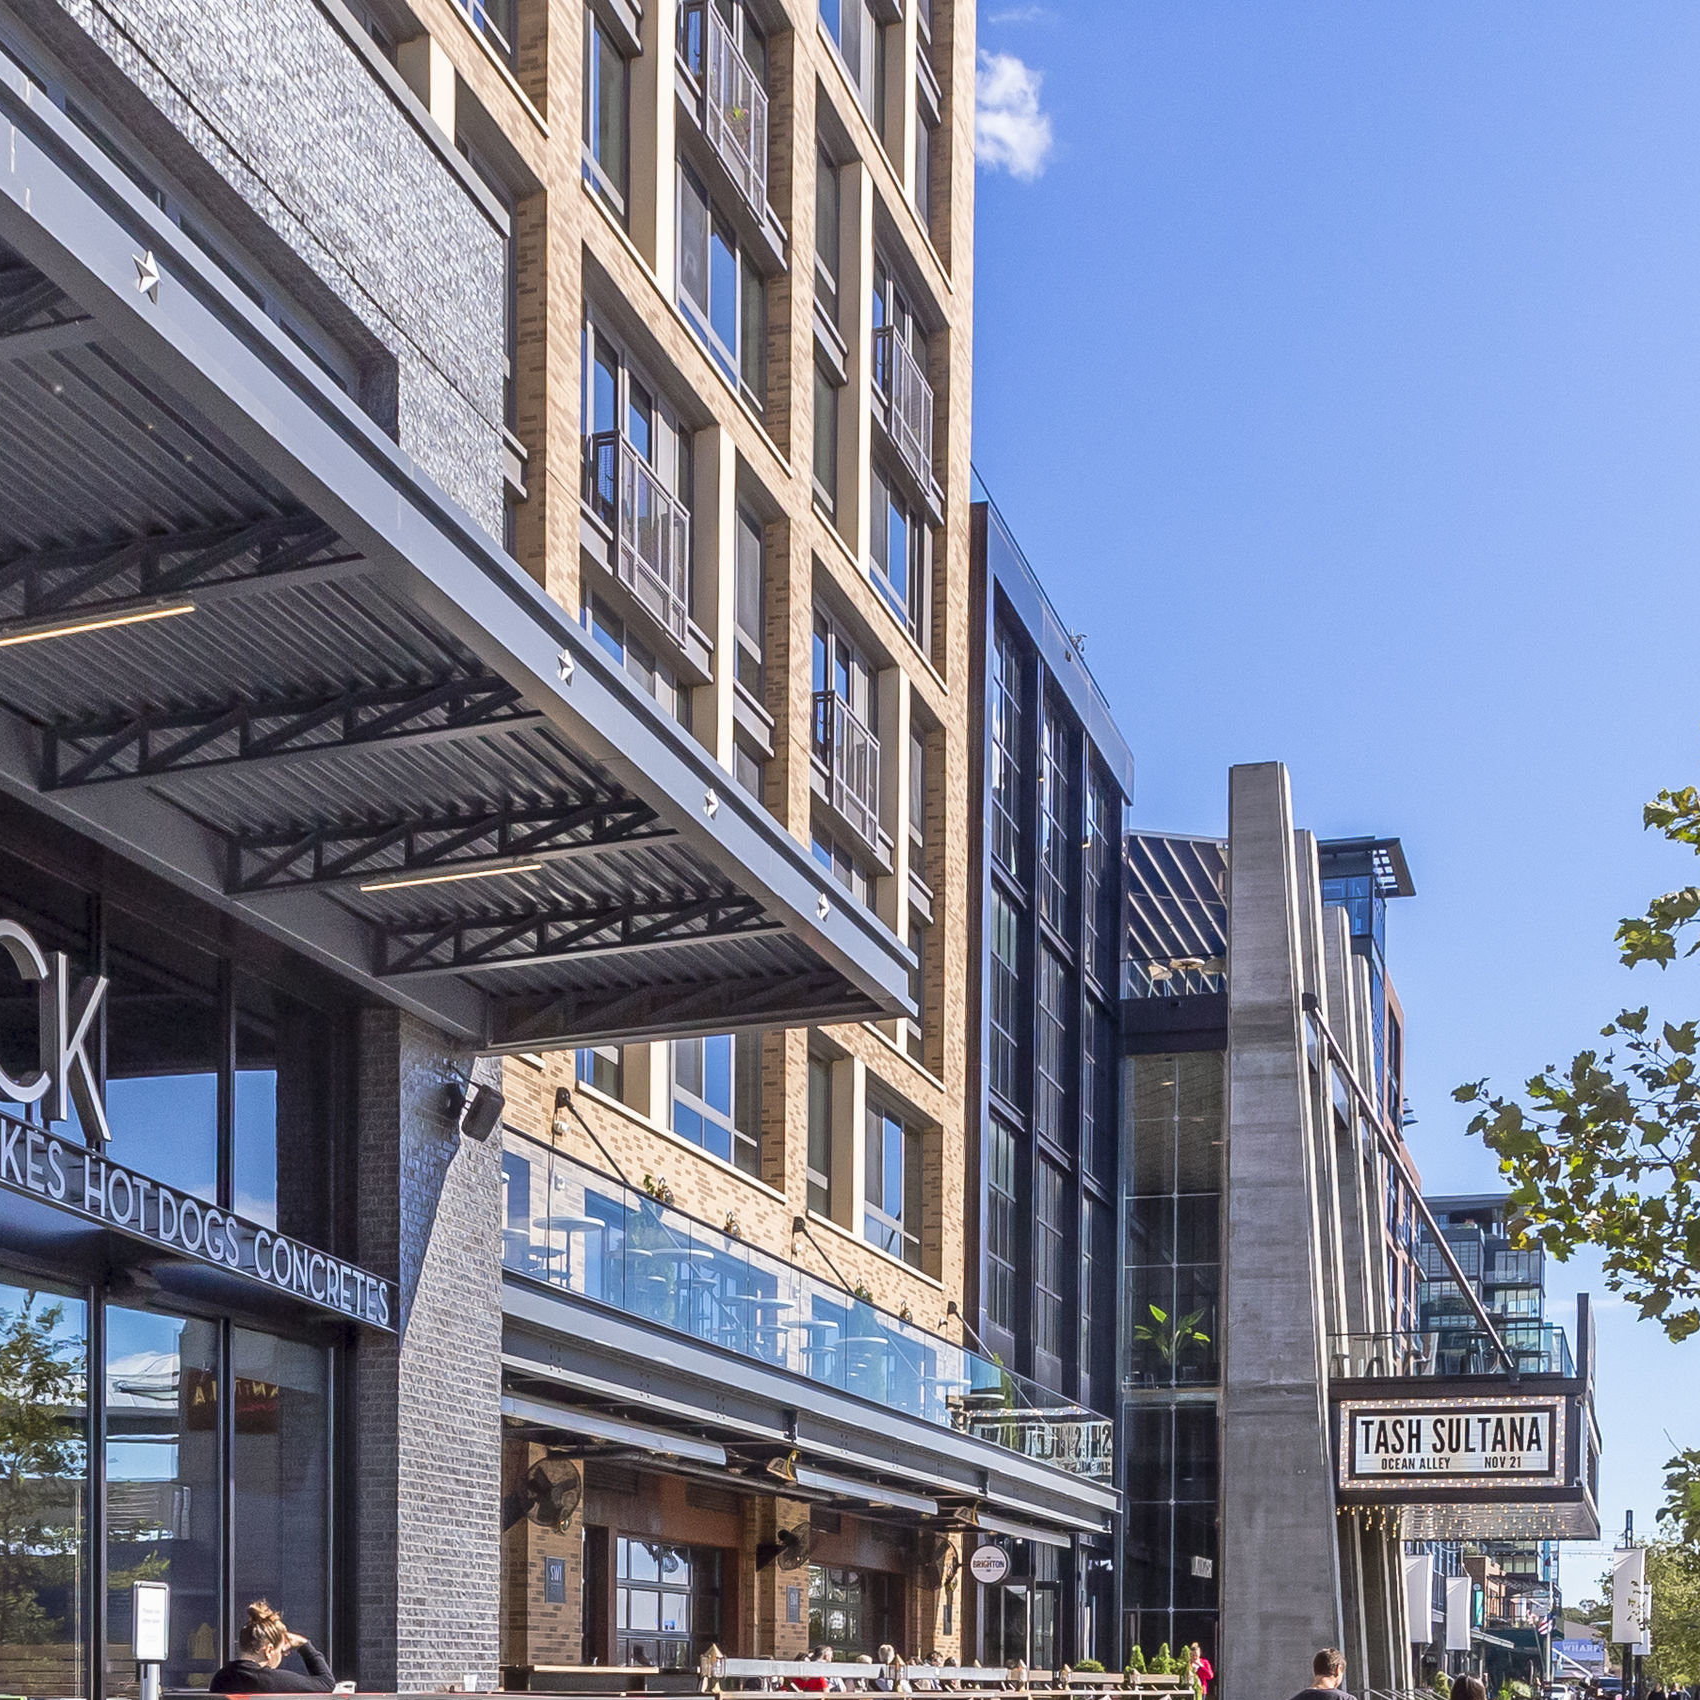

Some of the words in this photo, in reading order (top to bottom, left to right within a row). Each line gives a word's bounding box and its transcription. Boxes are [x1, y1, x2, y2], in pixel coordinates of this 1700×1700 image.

[84, 1154, 151, 1233] HOT
[158, 1187, 241, 1268] DOGS
[254, 1229, 390, 1326] CONCRETES
[1360, 1418, 1422, 1454] TASH
[1431, 1416, 1542, 1453] SULTANA
[1381, 1457, 1415, 1470] OCEAN
[1419, 1456, 1451, 1470] ALLEY
[1484, 1456, 1506, 1469] NOV
[1509, 1456, 1521, 1468] 21
[972, 1560, 1005, 1569] BRIGHTON
[1562, 1643, 1600, 1653] WHARF
